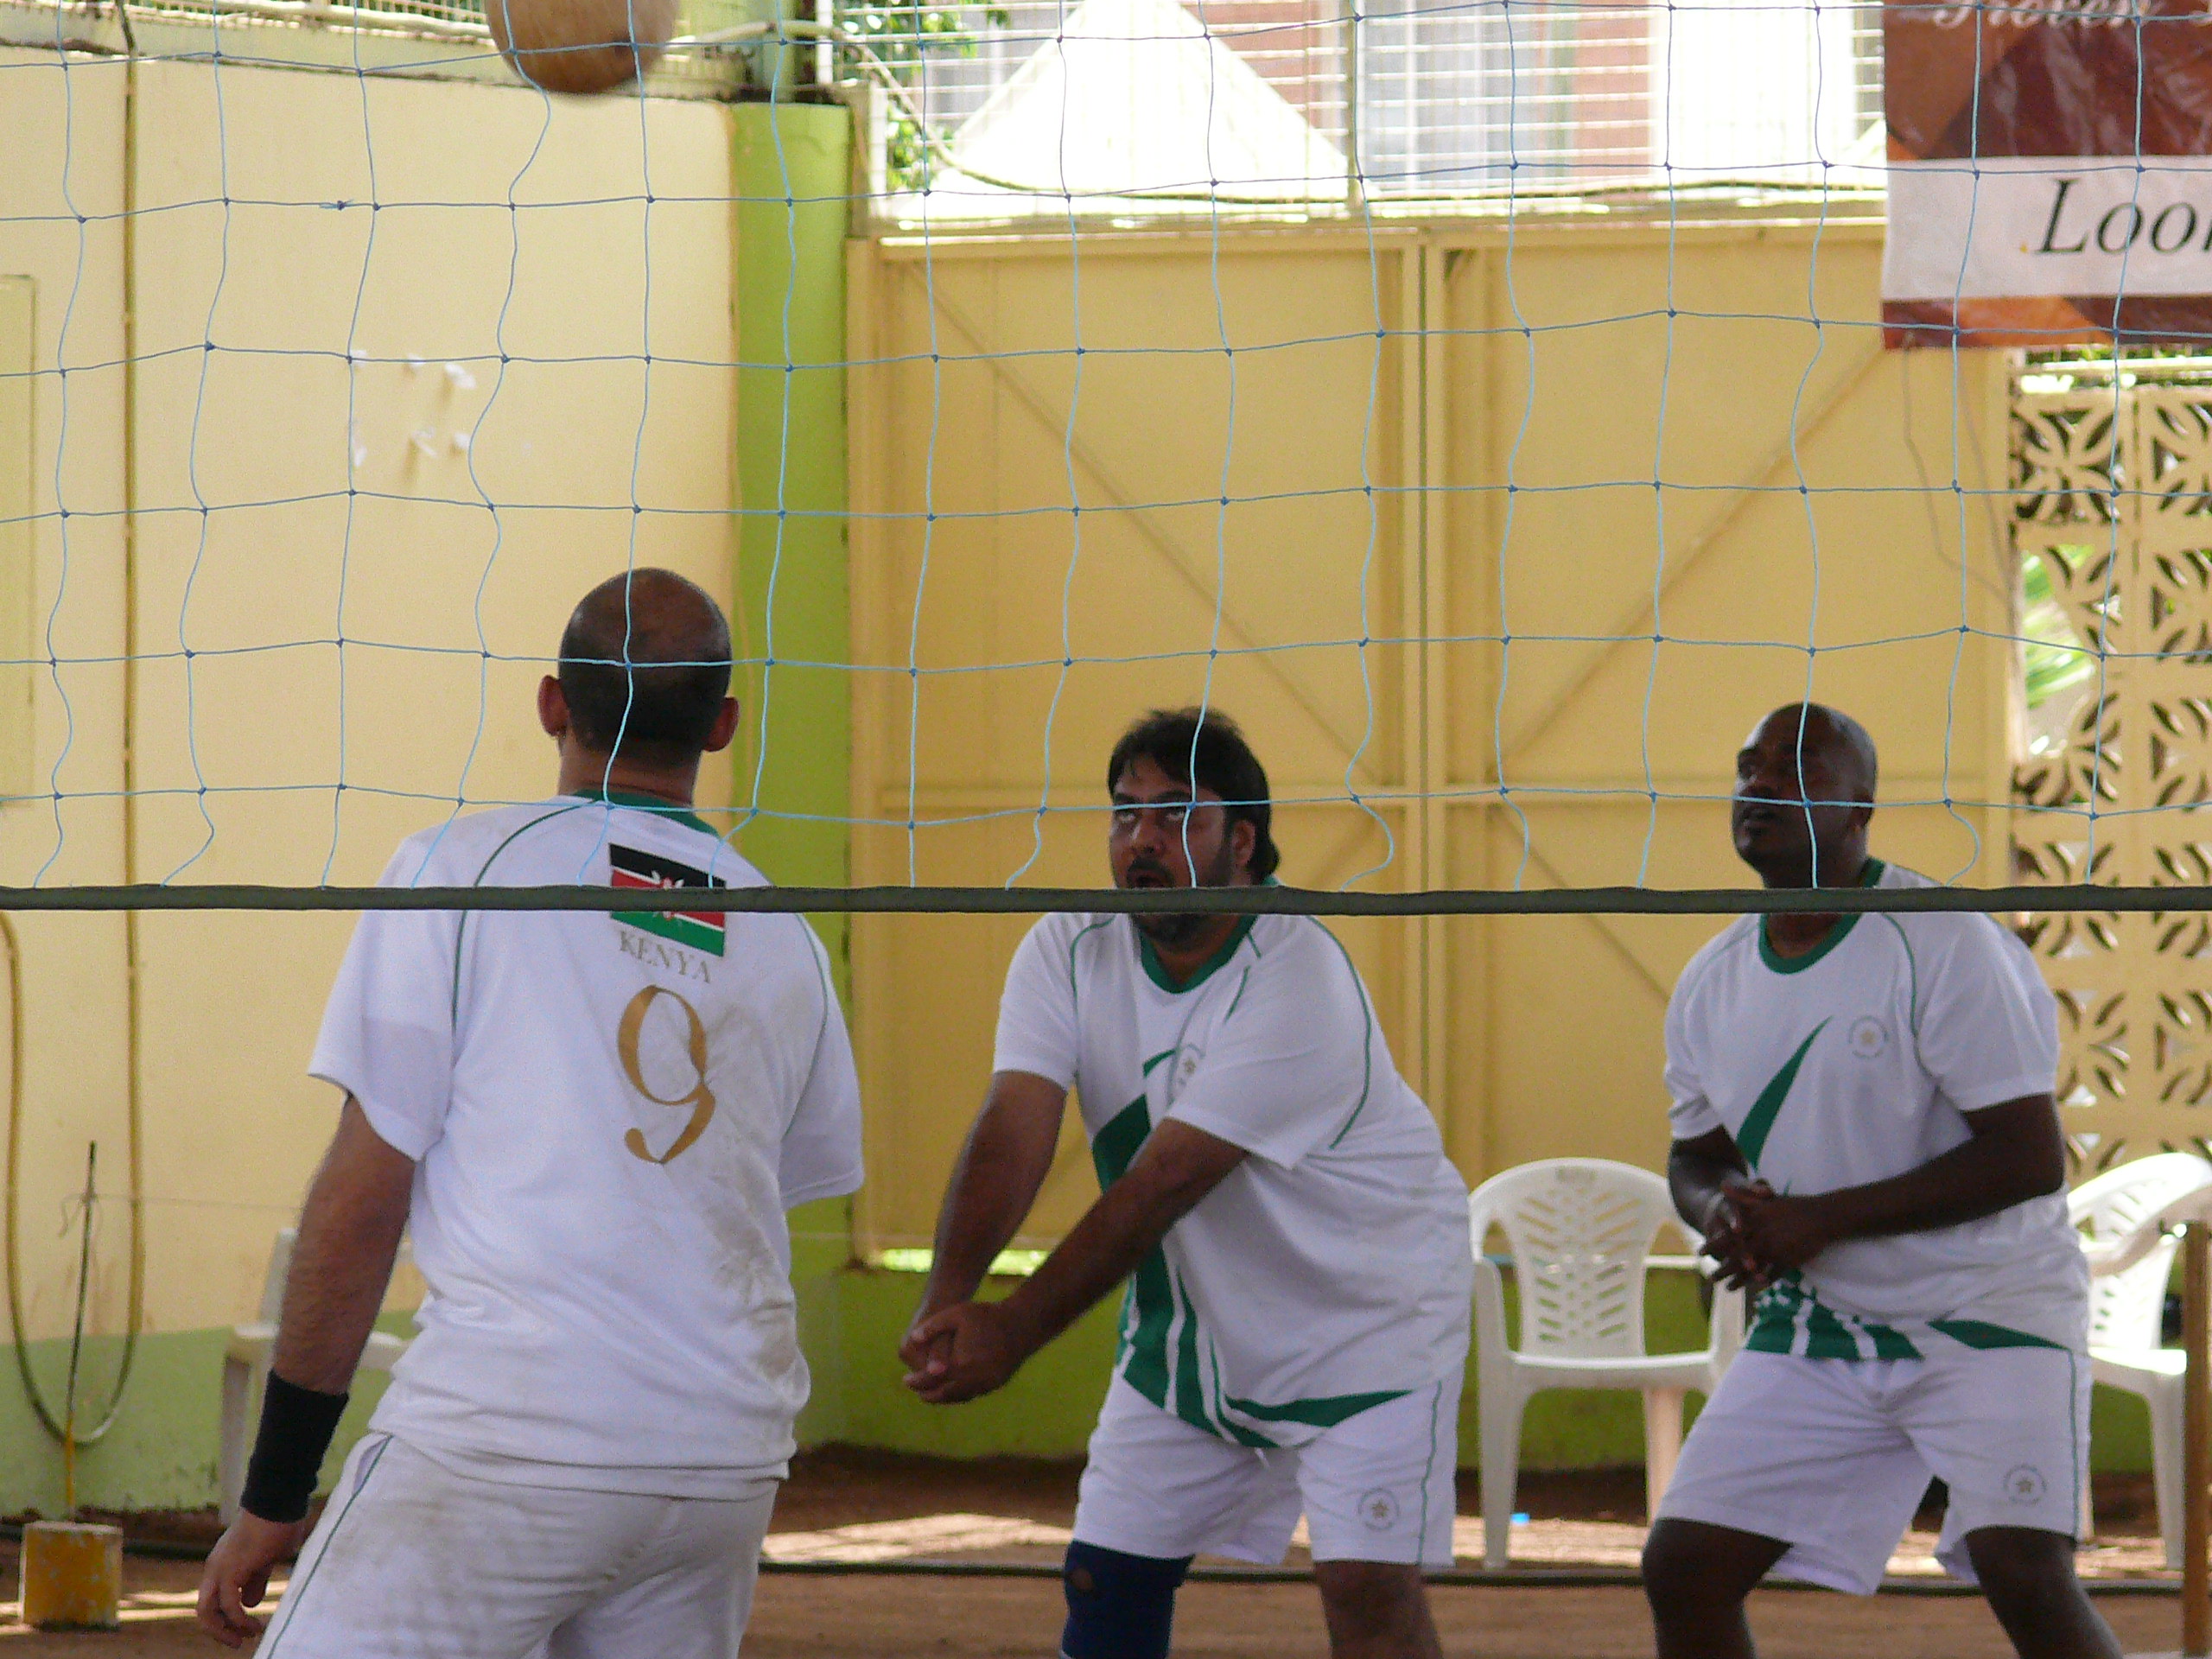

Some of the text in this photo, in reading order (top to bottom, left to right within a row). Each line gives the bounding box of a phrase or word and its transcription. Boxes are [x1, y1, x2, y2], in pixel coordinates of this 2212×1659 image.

[2035, 179, 2212, 254] Loo
[620, 930, 710, 983] KENYA
[619, 984, 715, 1165] 9
